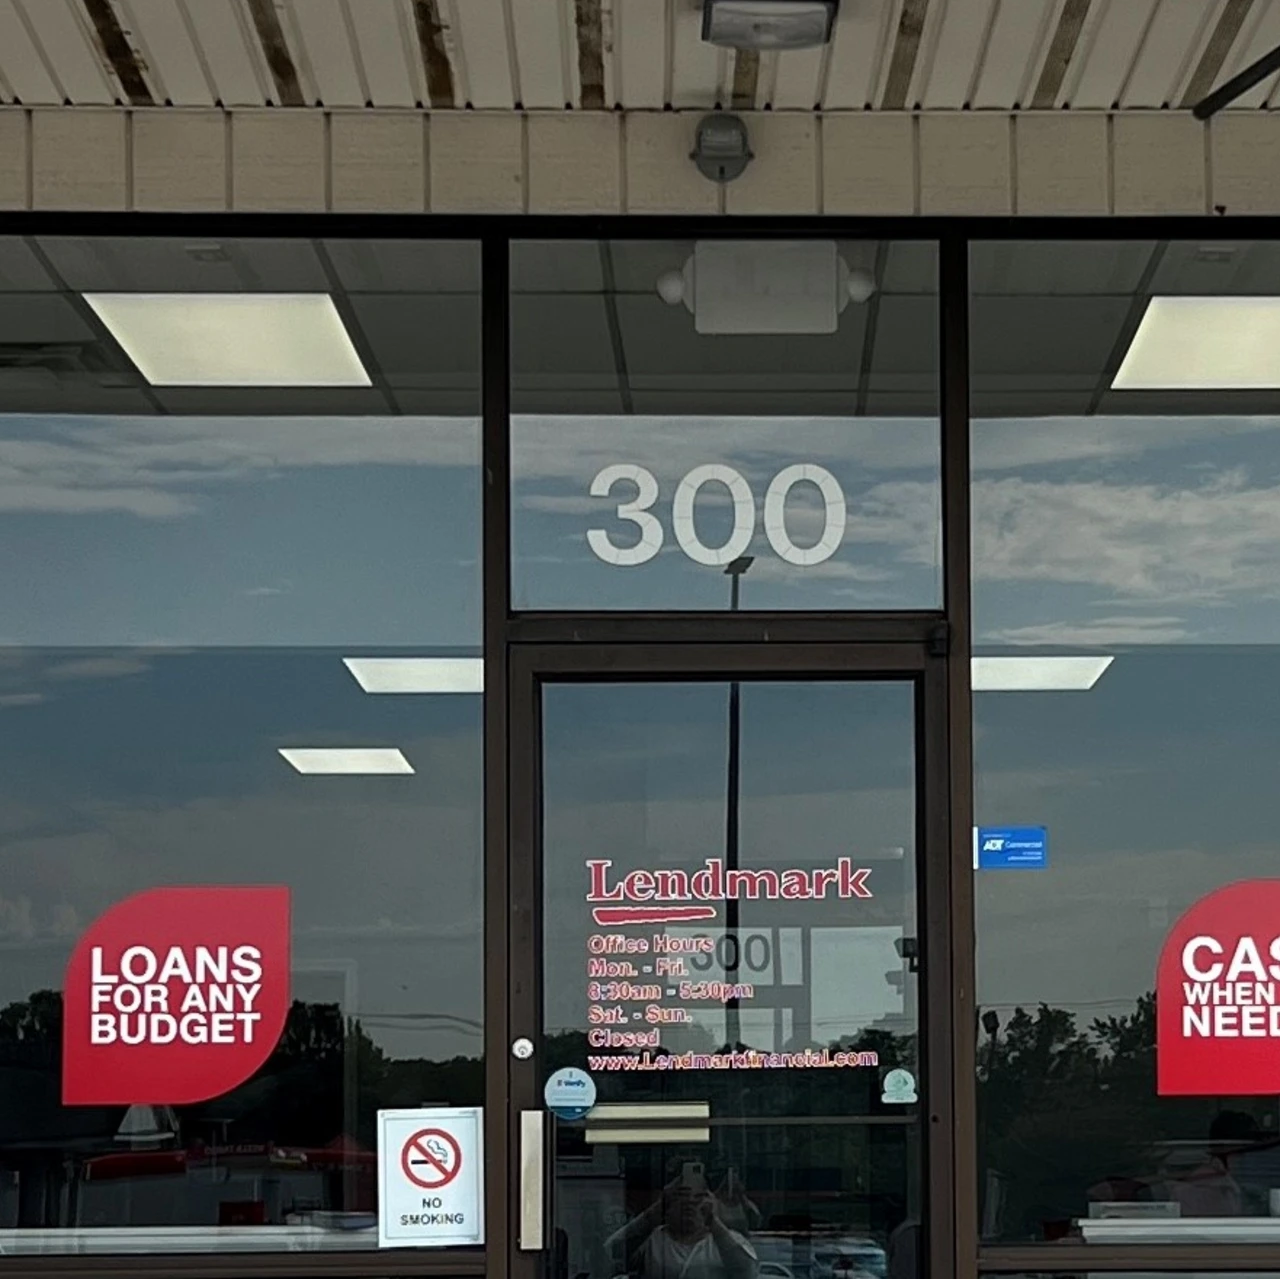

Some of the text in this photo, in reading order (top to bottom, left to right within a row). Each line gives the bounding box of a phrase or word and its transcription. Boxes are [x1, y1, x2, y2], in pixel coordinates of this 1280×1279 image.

[586, 463, 847, 566] 300
[586, 857, 873, 901] Lendmark
[587, 934, 714, 954] Office Hours
[91, 946, 263, 984] LOANS
[587, 958, 638, 977] Mon.
[655, 958, 689, 977] Fri.
[91, 983, 262, 1013] FOR ANY
[587, 982, 662, 1001] 8:30am
[679, 981, 754, 1003] 5:30pm
[1183, 982, 1275, 1005] WHEN
[587, 1005, 629, 1023] Sat.
[645, 1004, 693, 1023] Sun.
[91, 1012, 261, 1044] BUDGET
[587, 1028, 660, 1047] Closed
[422, 1197, 442, 1209] NO
[400, 1213, 464, 1226] SMOKING
